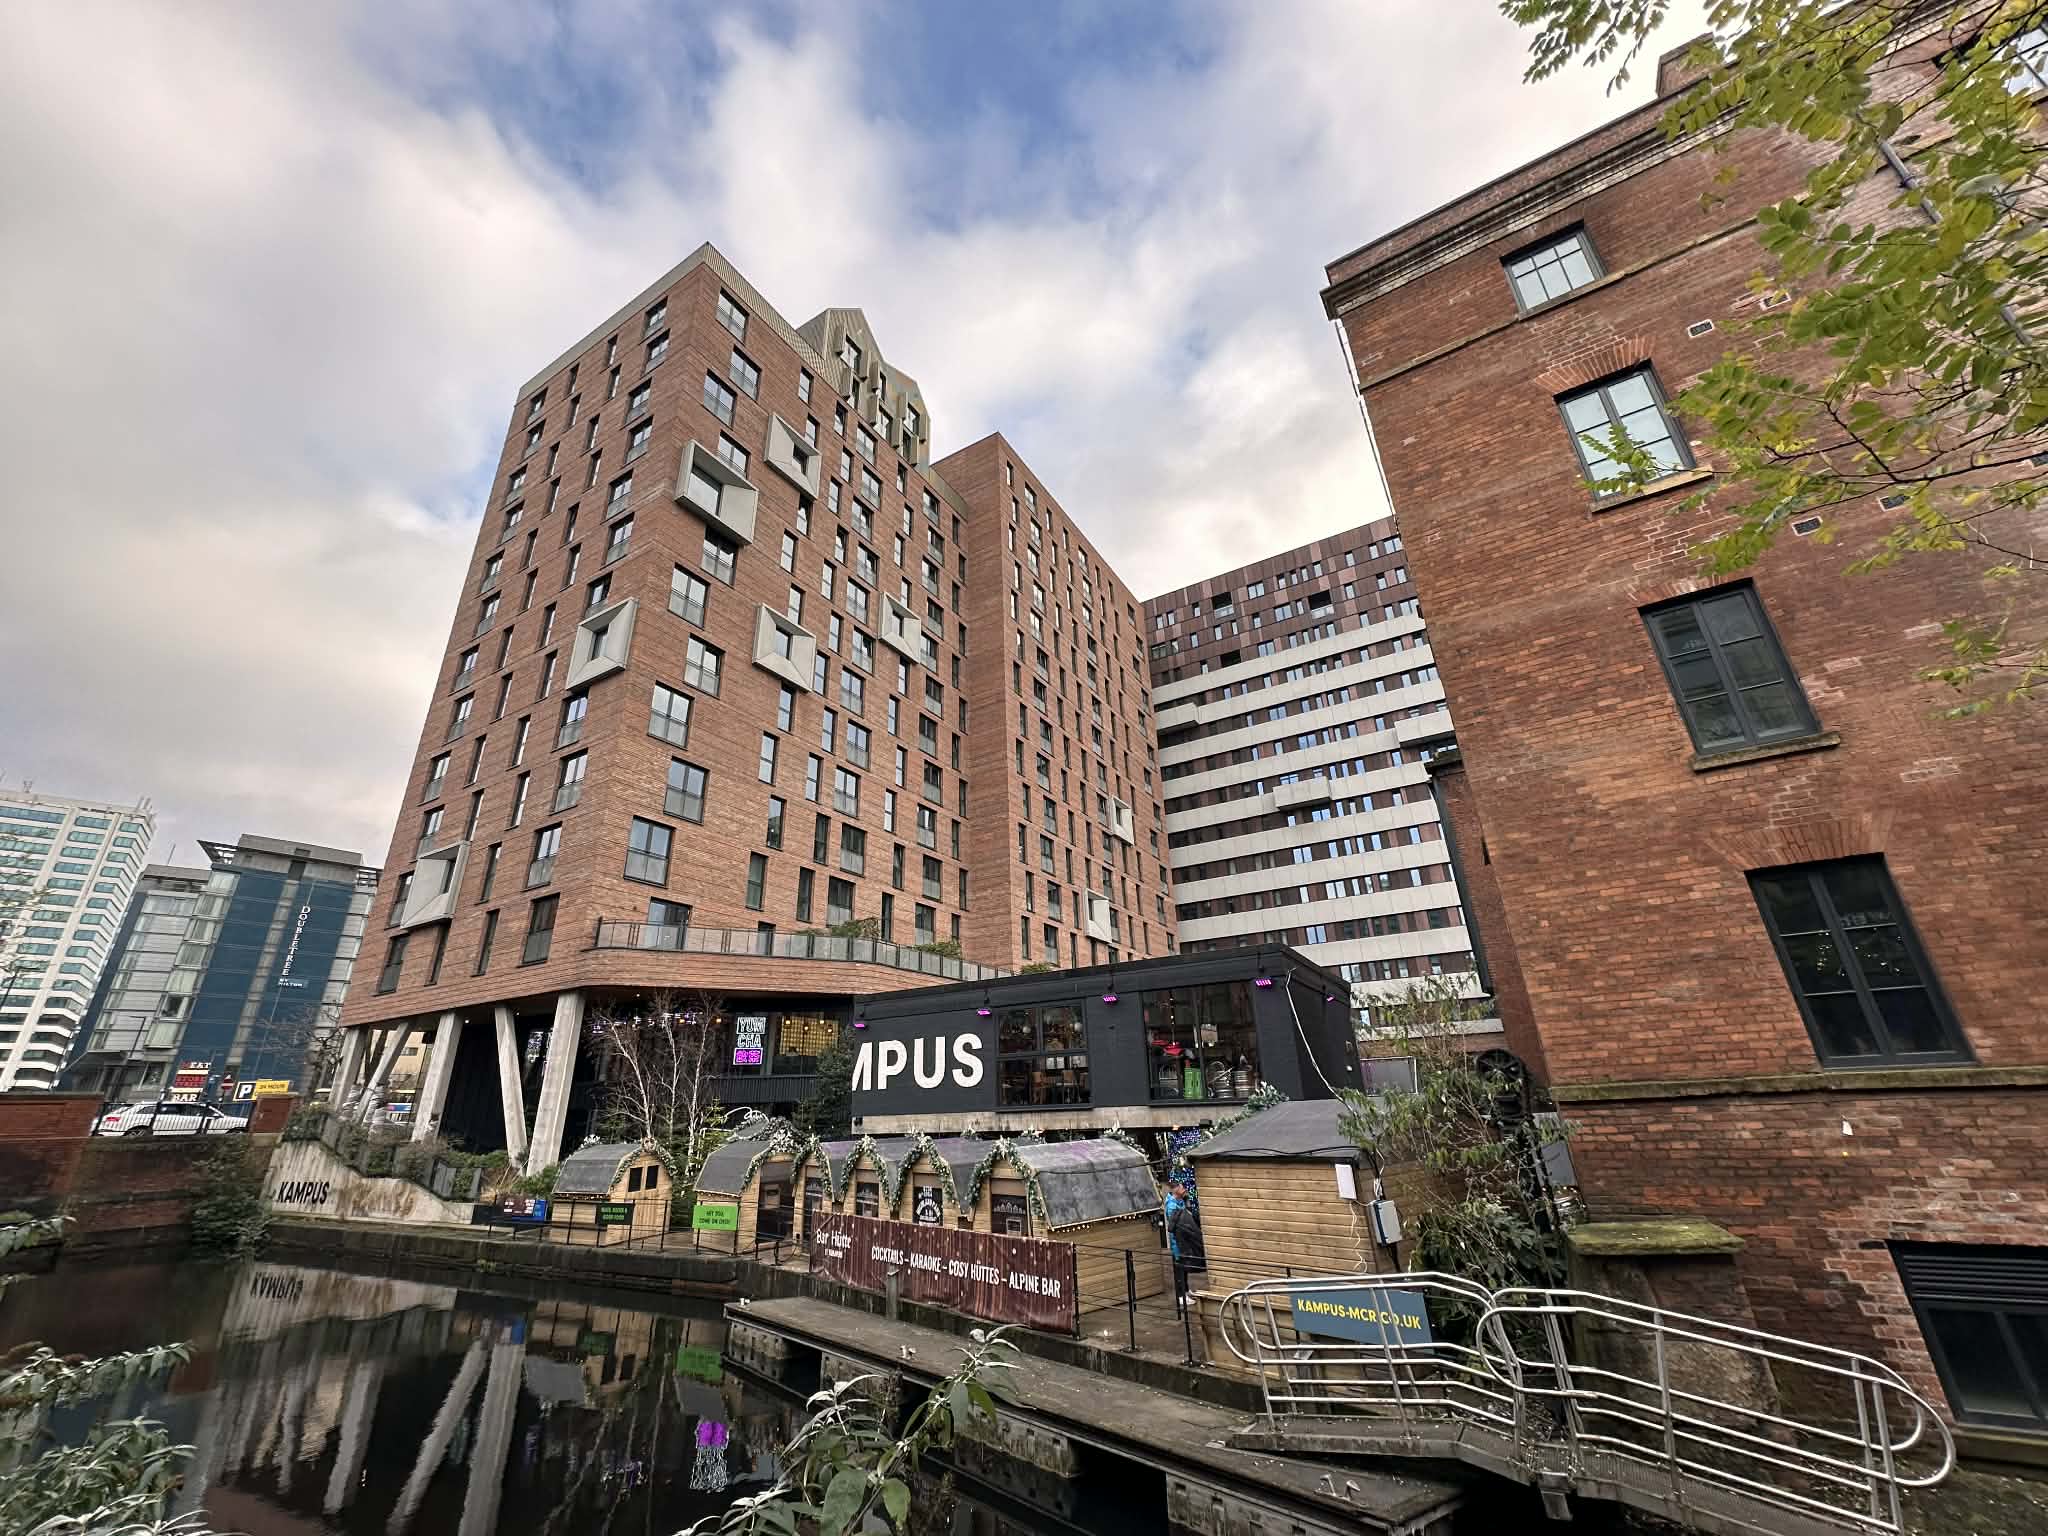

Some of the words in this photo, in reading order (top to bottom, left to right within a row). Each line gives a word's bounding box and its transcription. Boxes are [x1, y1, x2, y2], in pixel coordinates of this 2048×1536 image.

[282, 905, 311, 976] DOUBLETREE
[737, 1034, 761, 1048] CHA
[173, 1093, 198, 1102] BAR
[238, 1084, 252, 1098] P
[277, 1181, 330, 1205] KAMPUS
[816, 1228, 829, 1245] Bar
[871, 1246, 904, 1265] COCKTAILS
[910, 1252, 942, 1273] KARAOKE
[948, 1259, 969, 1279] COSY
[970, 1260, 1000, 1285] HÜTTES
[1009, 1271, 1040, 1294] ALPINE
[1041, 1277, 1061, 1298] BAR
